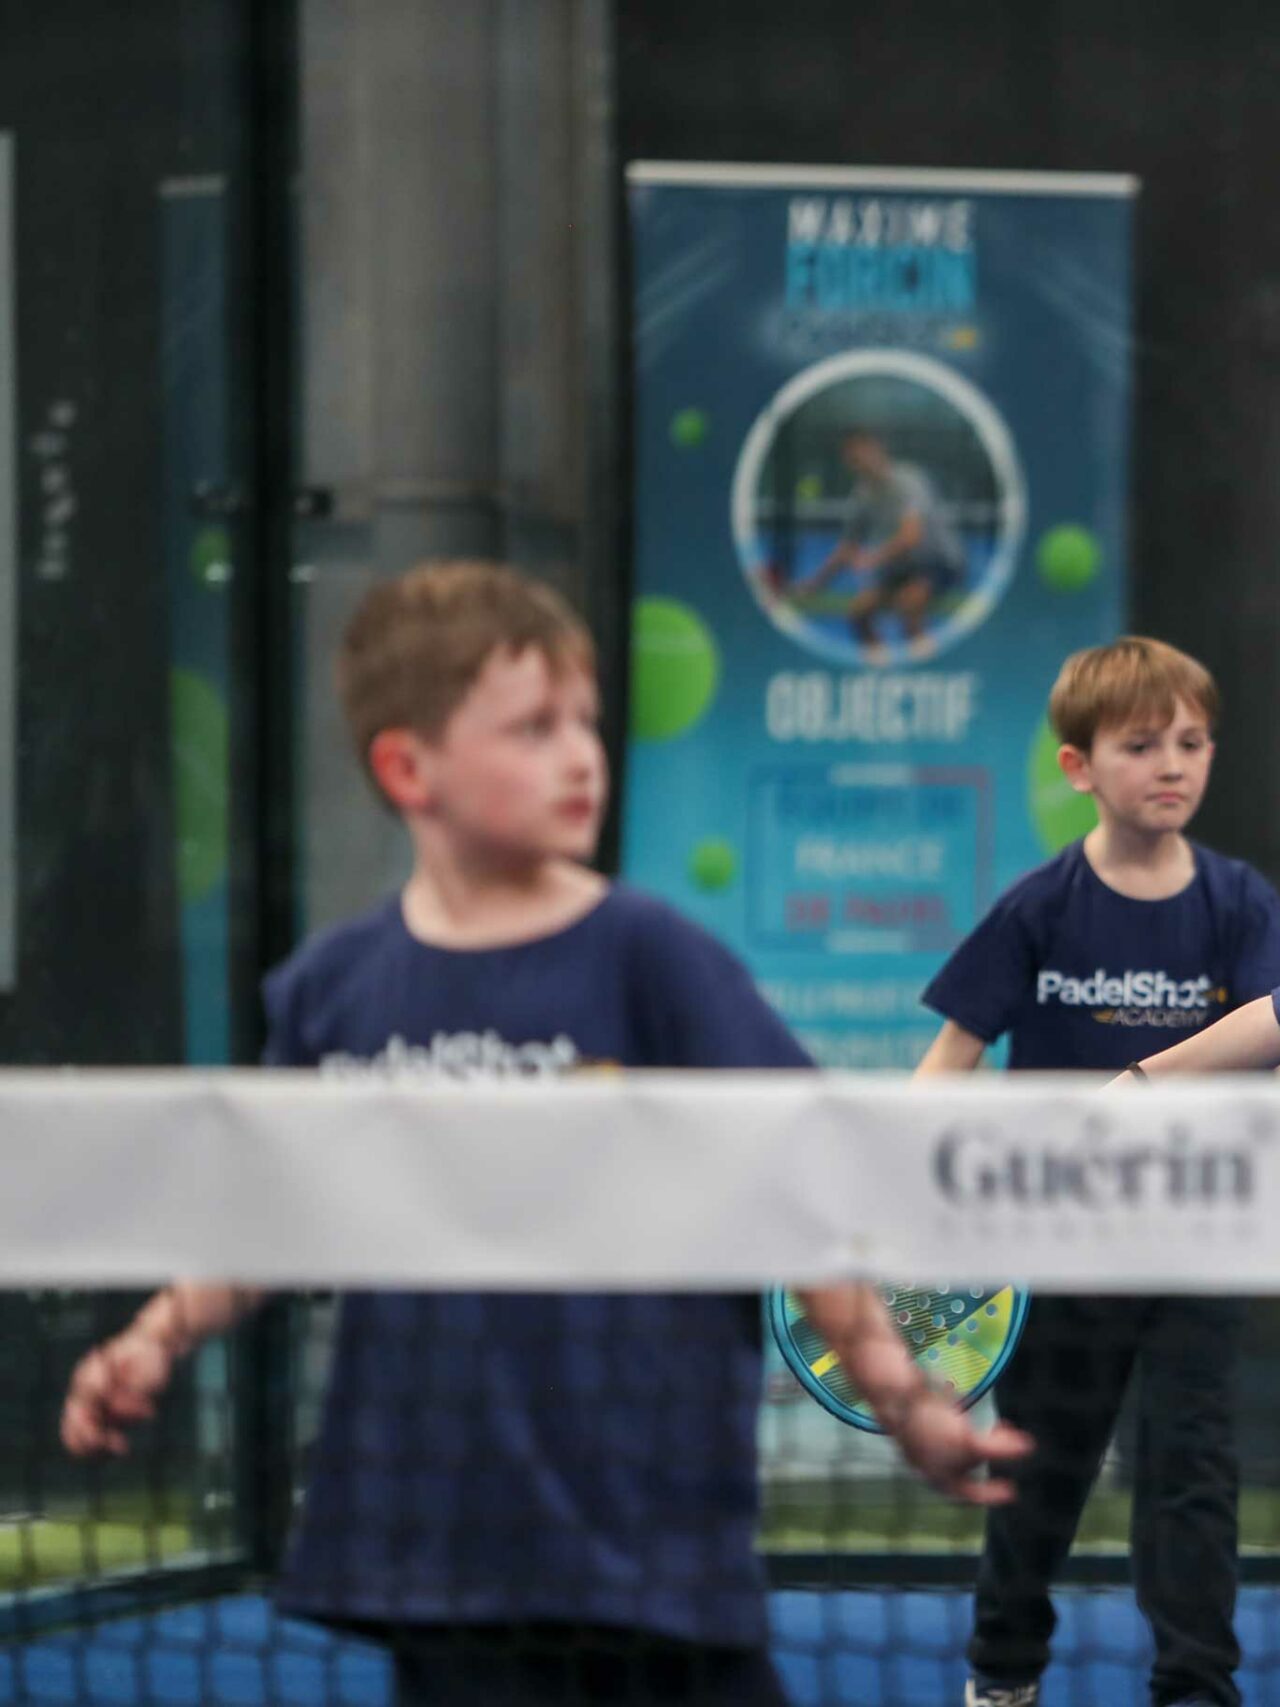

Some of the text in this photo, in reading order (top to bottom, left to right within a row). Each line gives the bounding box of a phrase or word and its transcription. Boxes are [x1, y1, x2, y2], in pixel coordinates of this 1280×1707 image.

[787, 198, 974, 252] MAXIME
[765, 671, 977, 742] OBJECTIF
[1036, 968, 1212, 1008] PadelShot
[1110, 1008, 1208, 1027] ACADEMY
[932, 1113, 1256, 1210] Guérin
